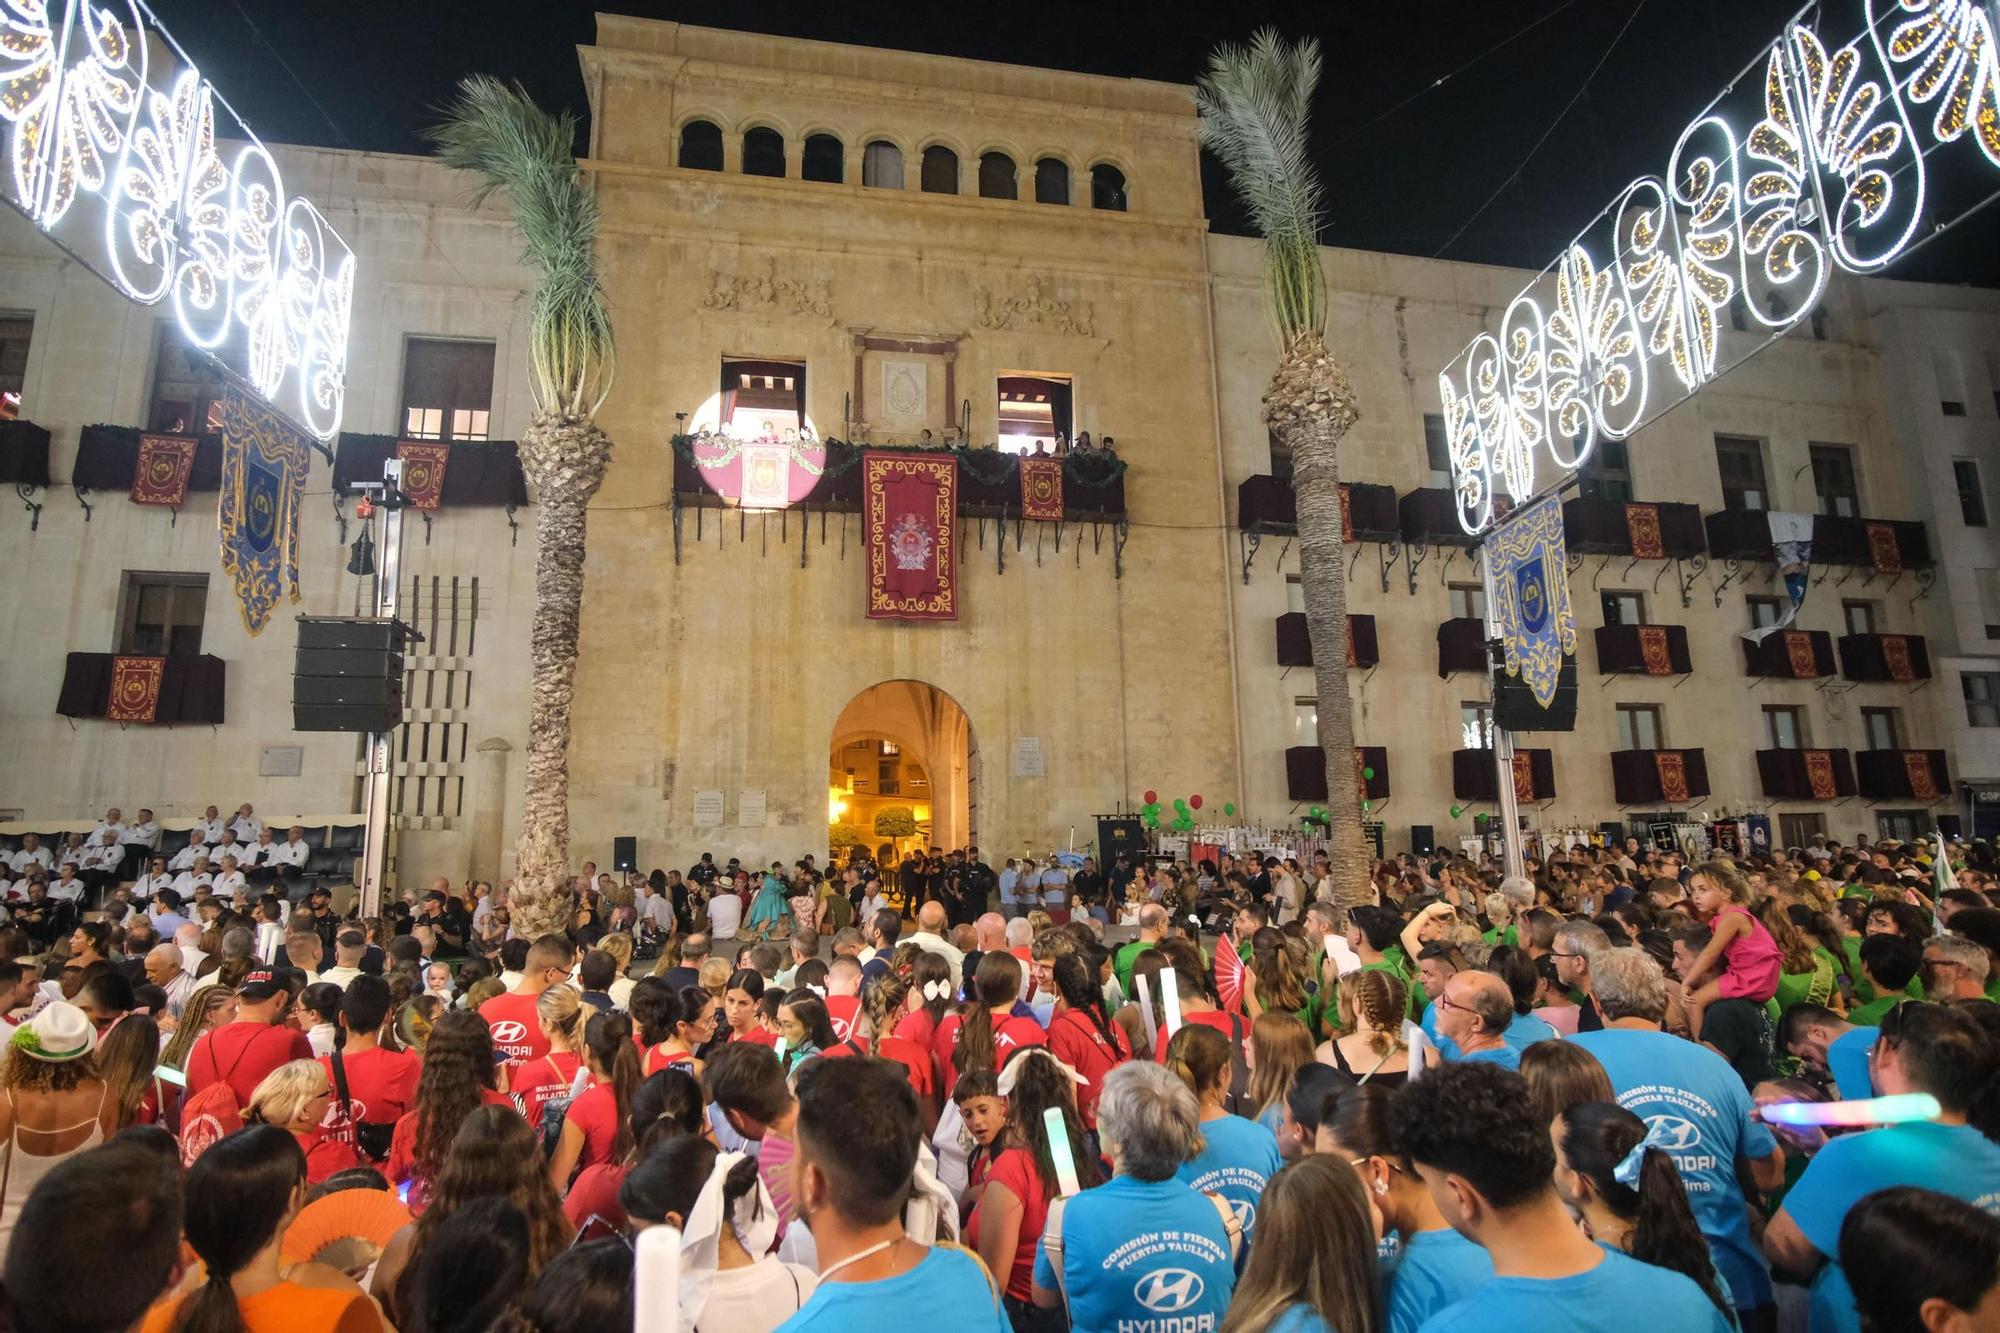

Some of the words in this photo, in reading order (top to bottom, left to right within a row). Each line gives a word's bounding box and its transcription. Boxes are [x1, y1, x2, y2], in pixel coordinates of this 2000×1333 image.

[1616, 1085, 1657, 1104] OMISIÓN
[1659, 1085, 1676, 1094] DE
[1678, 1089, 1718, 1117] FIESTAS
[1665, 1095, 1707, 1117] TAULLAS
[1222, 1168, 1236, 1176] DE
[1670, 1154, 1716, 1171] NDAI
[1102, 1233, 1158, 1269] COMISIÓN
[1162, 1231, 1180, 1241] DE
[1184, 1232, 1226, 1260] FIESTAS
[1118, 1243, 1165, 1270] PUERTAS
[1168, 1242, 1215, 1264] TAULLAS
[1118, 1312, 1215, 1333] HYUNDAI
